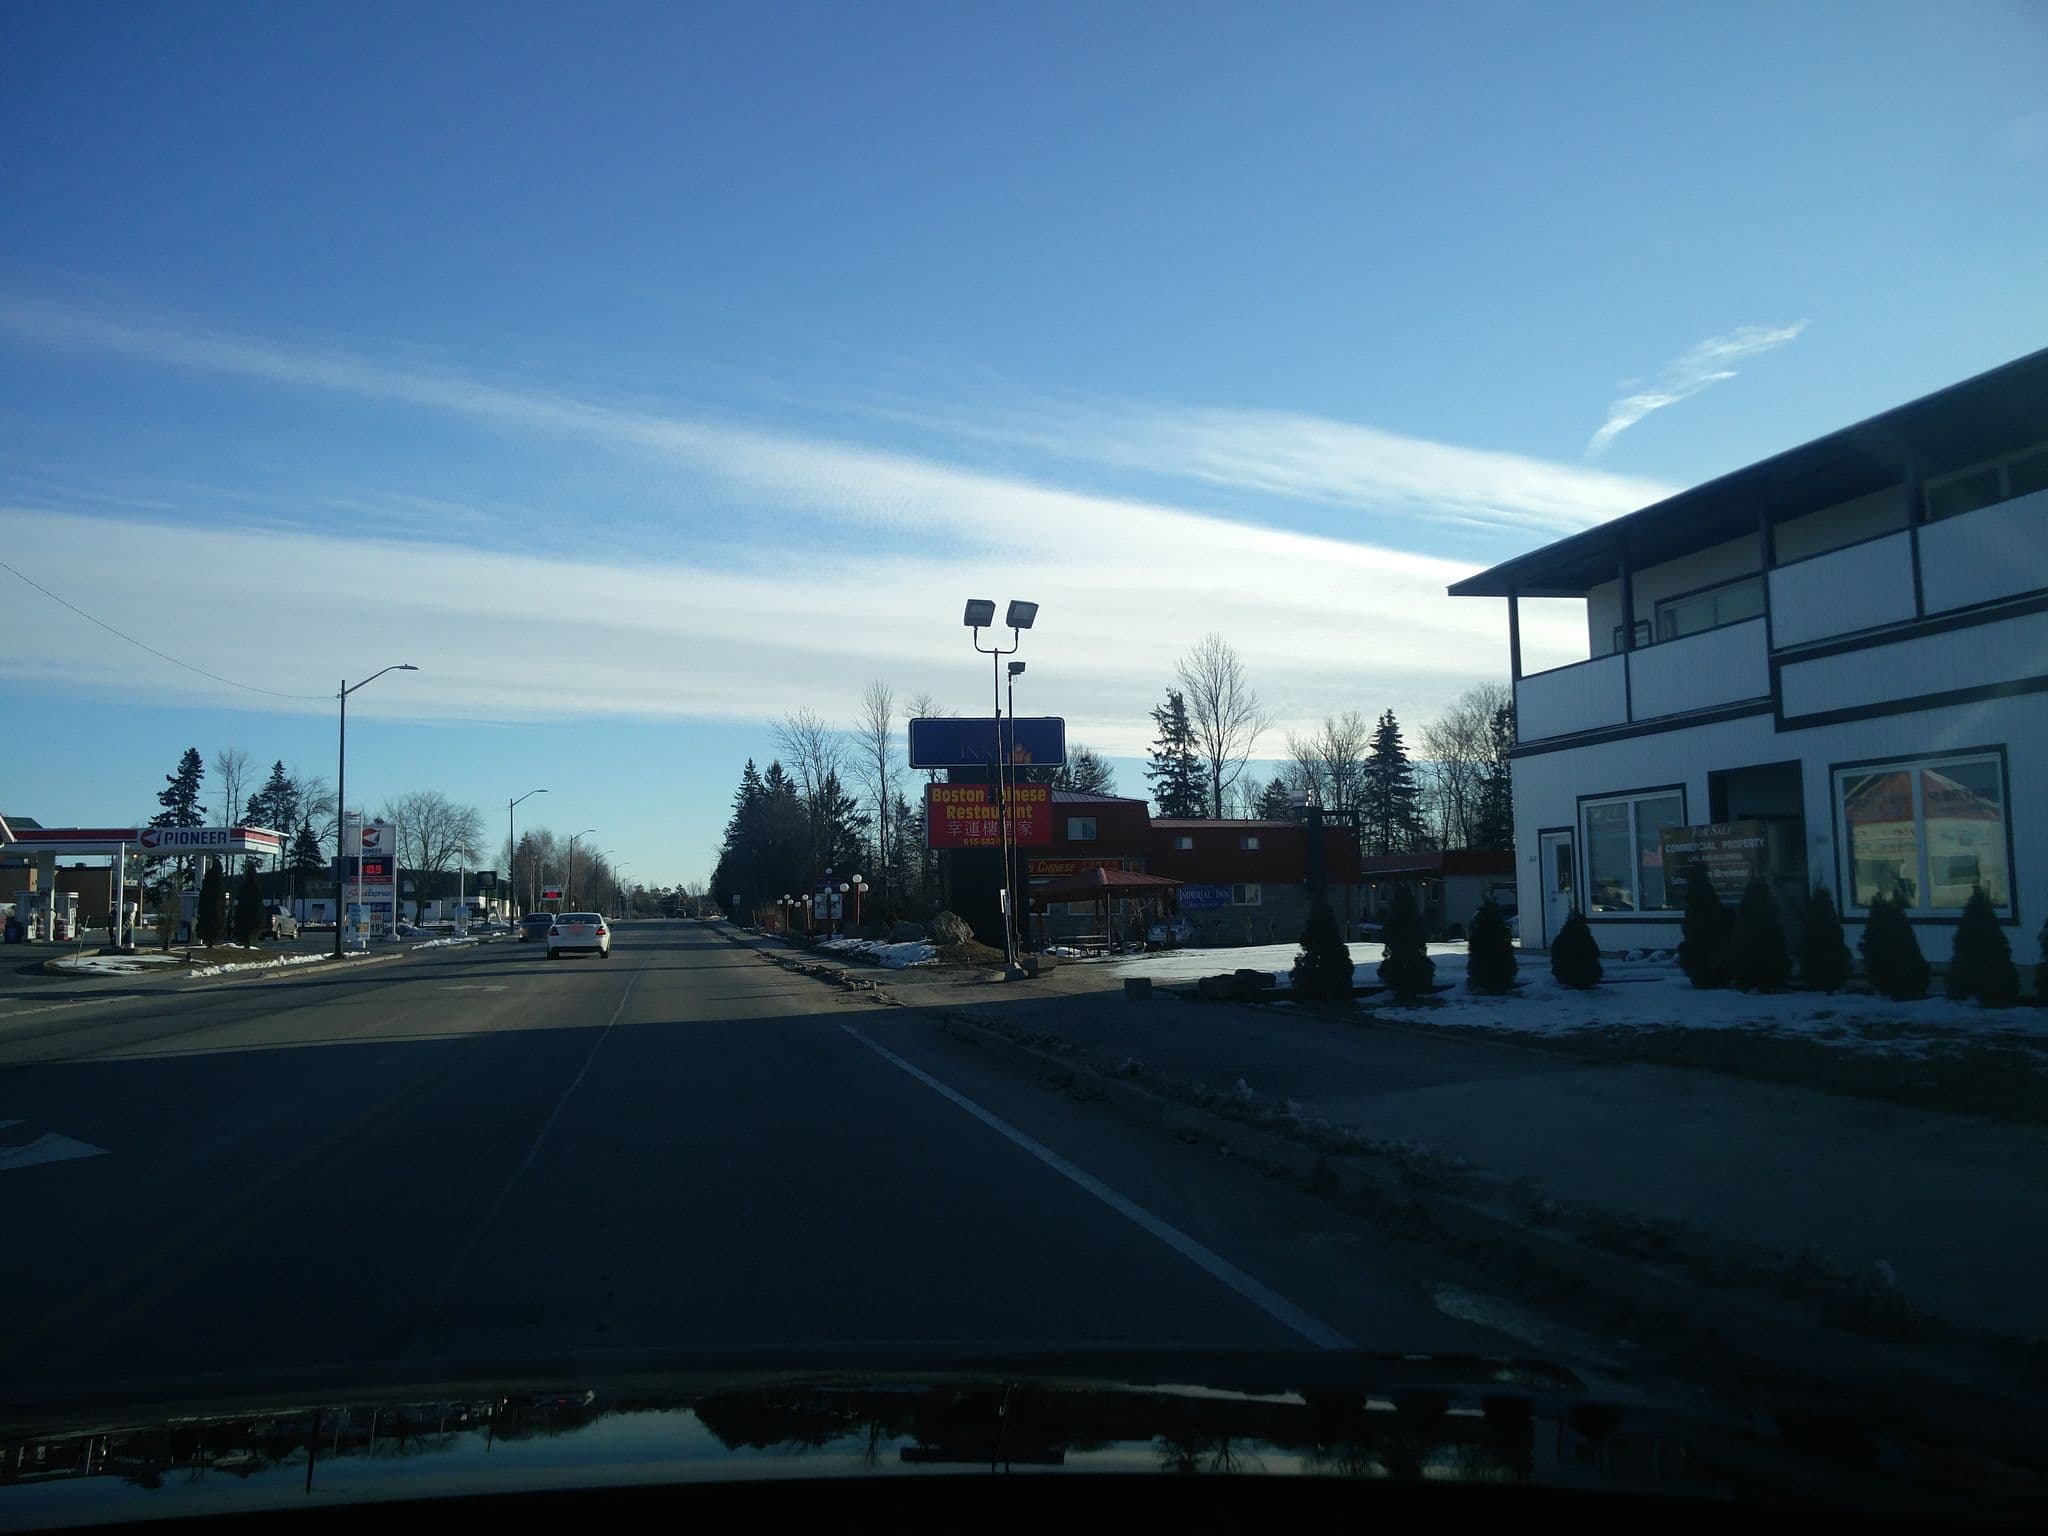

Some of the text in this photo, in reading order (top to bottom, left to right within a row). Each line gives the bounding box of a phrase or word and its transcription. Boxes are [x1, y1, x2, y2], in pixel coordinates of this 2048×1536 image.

[932, 786, 1047, 802] Boston inese
[946, 804, 1033, 819] Restauant
[164, 831, 227, 845] PIONEER
[1722, 838, 1764, 850] PROPERTY
